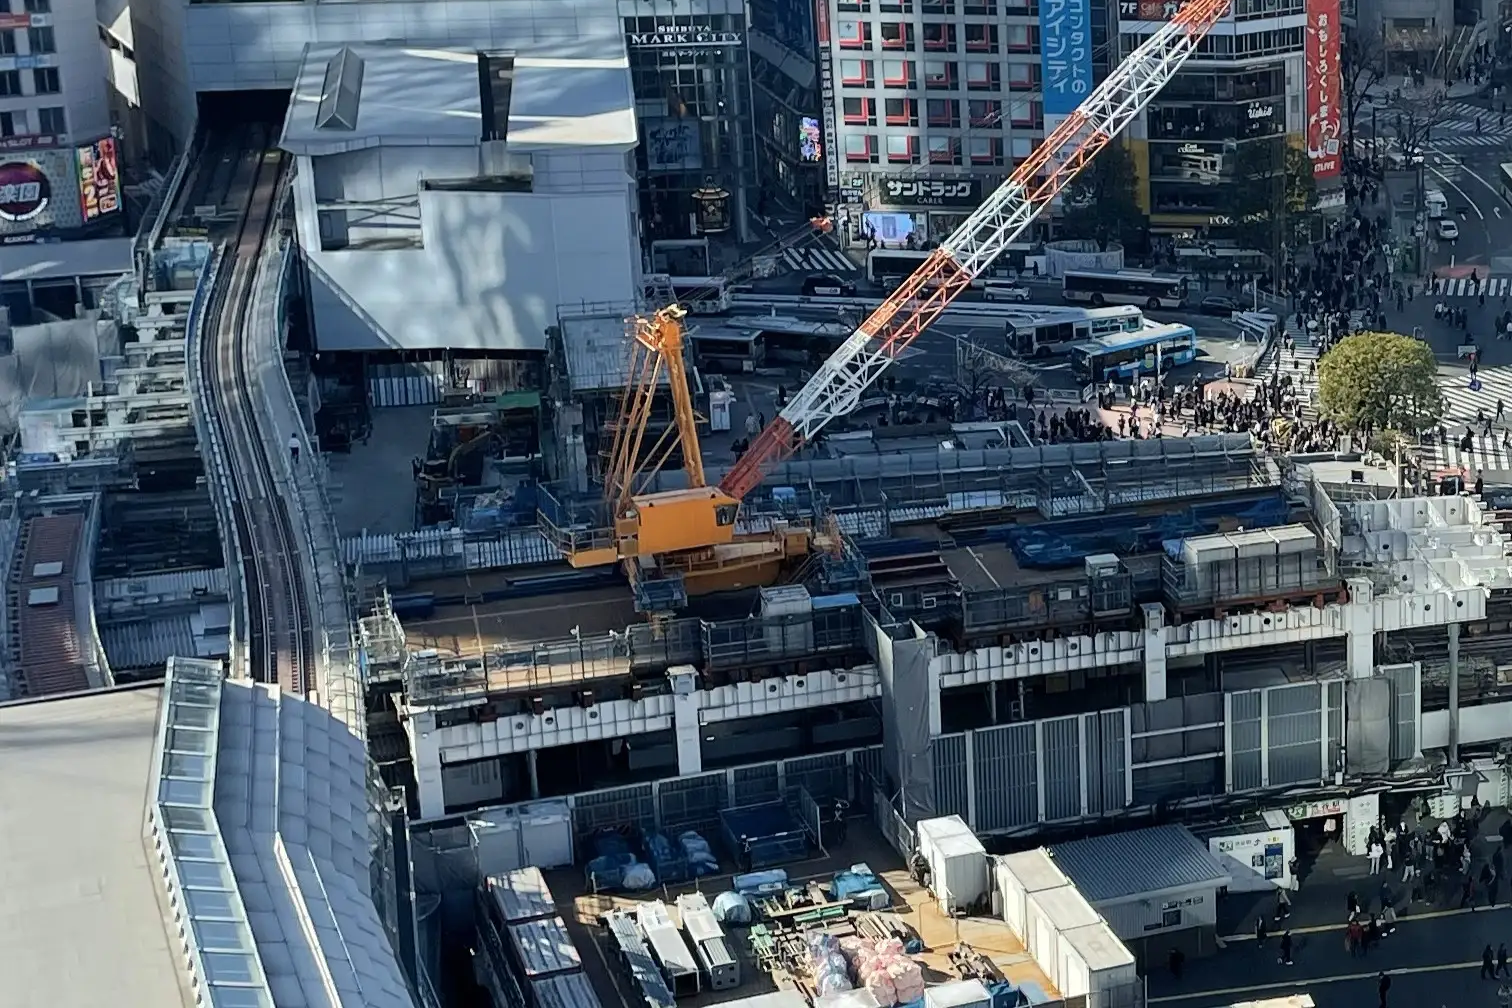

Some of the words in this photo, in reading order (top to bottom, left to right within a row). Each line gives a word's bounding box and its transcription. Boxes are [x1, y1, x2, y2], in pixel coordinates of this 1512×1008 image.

[1120, 2, 1138, 14] 7F
[631, 34, 688, 44] MARK
[696, 32, 742, 43] CITY
[886, 180, 972, 197] サンドラッグ
